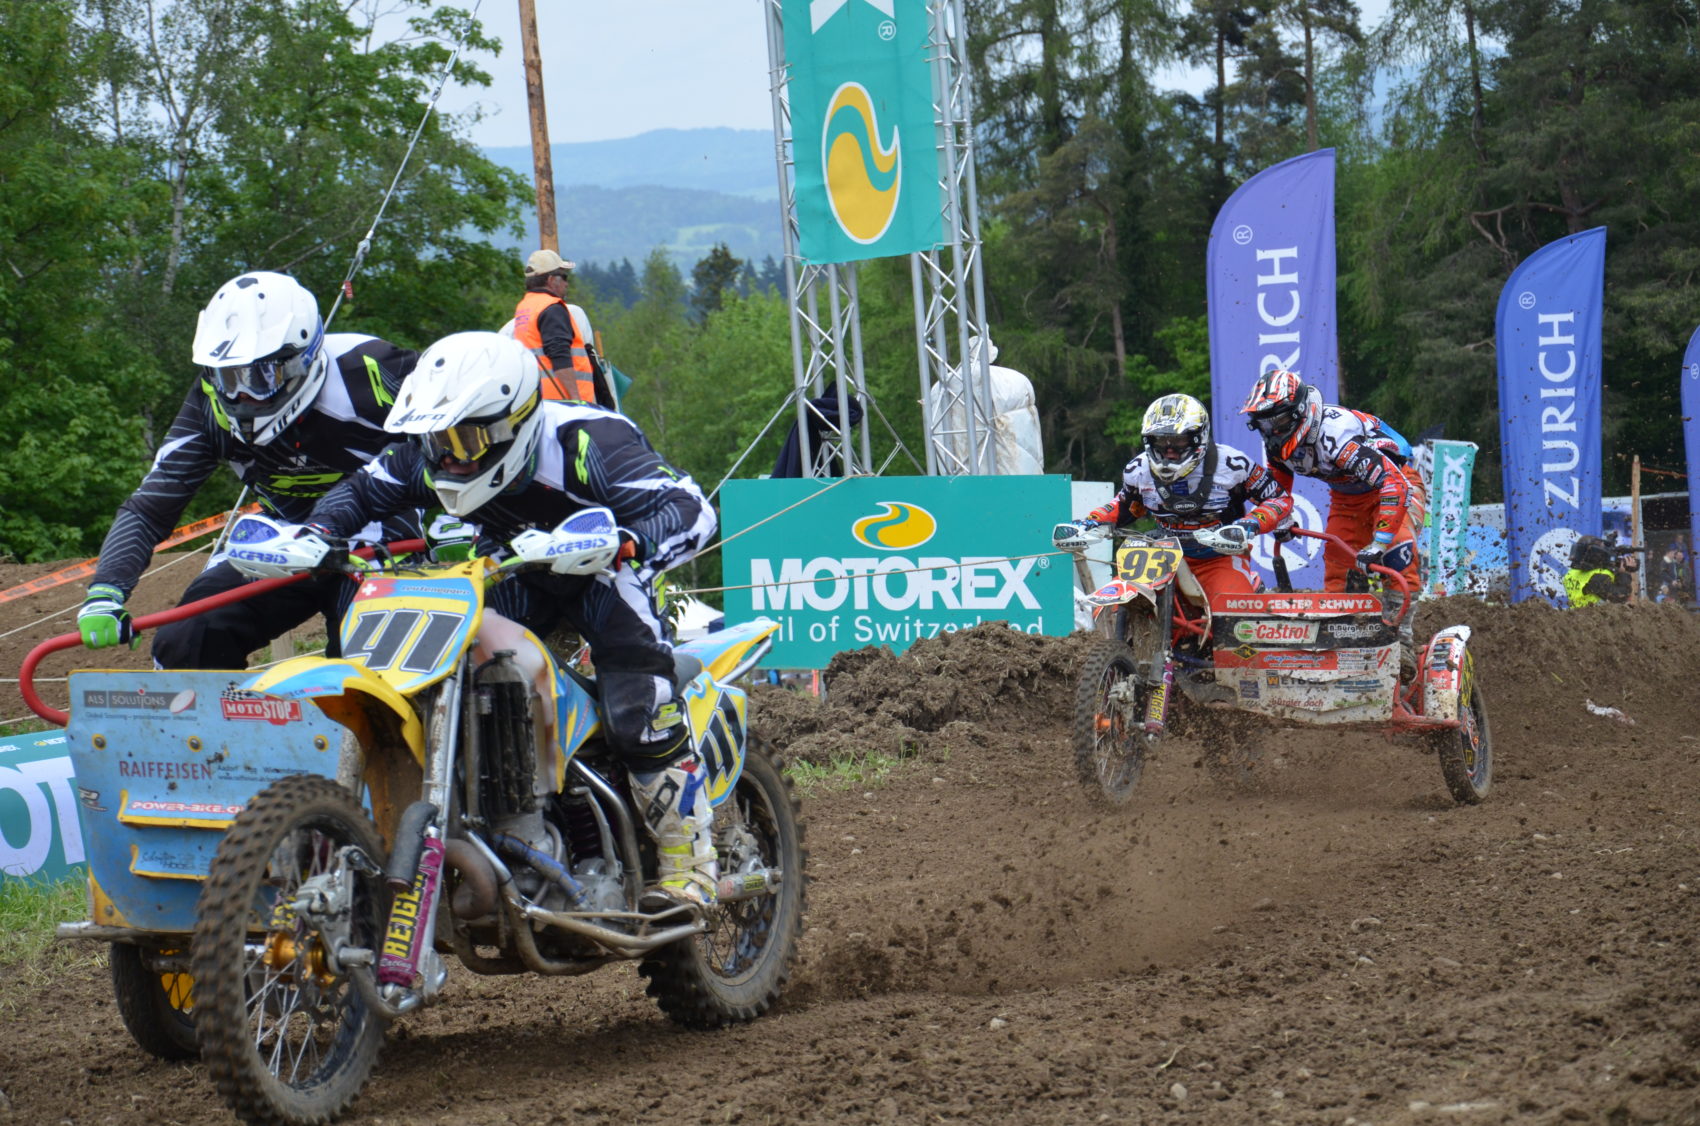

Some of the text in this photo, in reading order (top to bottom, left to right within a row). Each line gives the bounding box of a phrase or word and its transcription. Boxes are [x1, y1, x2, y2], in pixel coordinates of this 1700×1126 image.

[1537, 311, 1580, 510] ZURICH
[228, 548, 288, 565] ACERBIS
[545, 538, 608, 557] ACERBIS
[1120, 550, 1176, 581] 93
[750, 556, 1043, 611] MOTOREX
[1226, 599, 1374, 610] MOTO CENTER SCHWYZ
[809, 615, 839, 642] of
[1256, 624, 1310, 640] Castrol
[342, 608, 466, 675] 41
[119, 760, 212, 780] RAIFFEISEN
